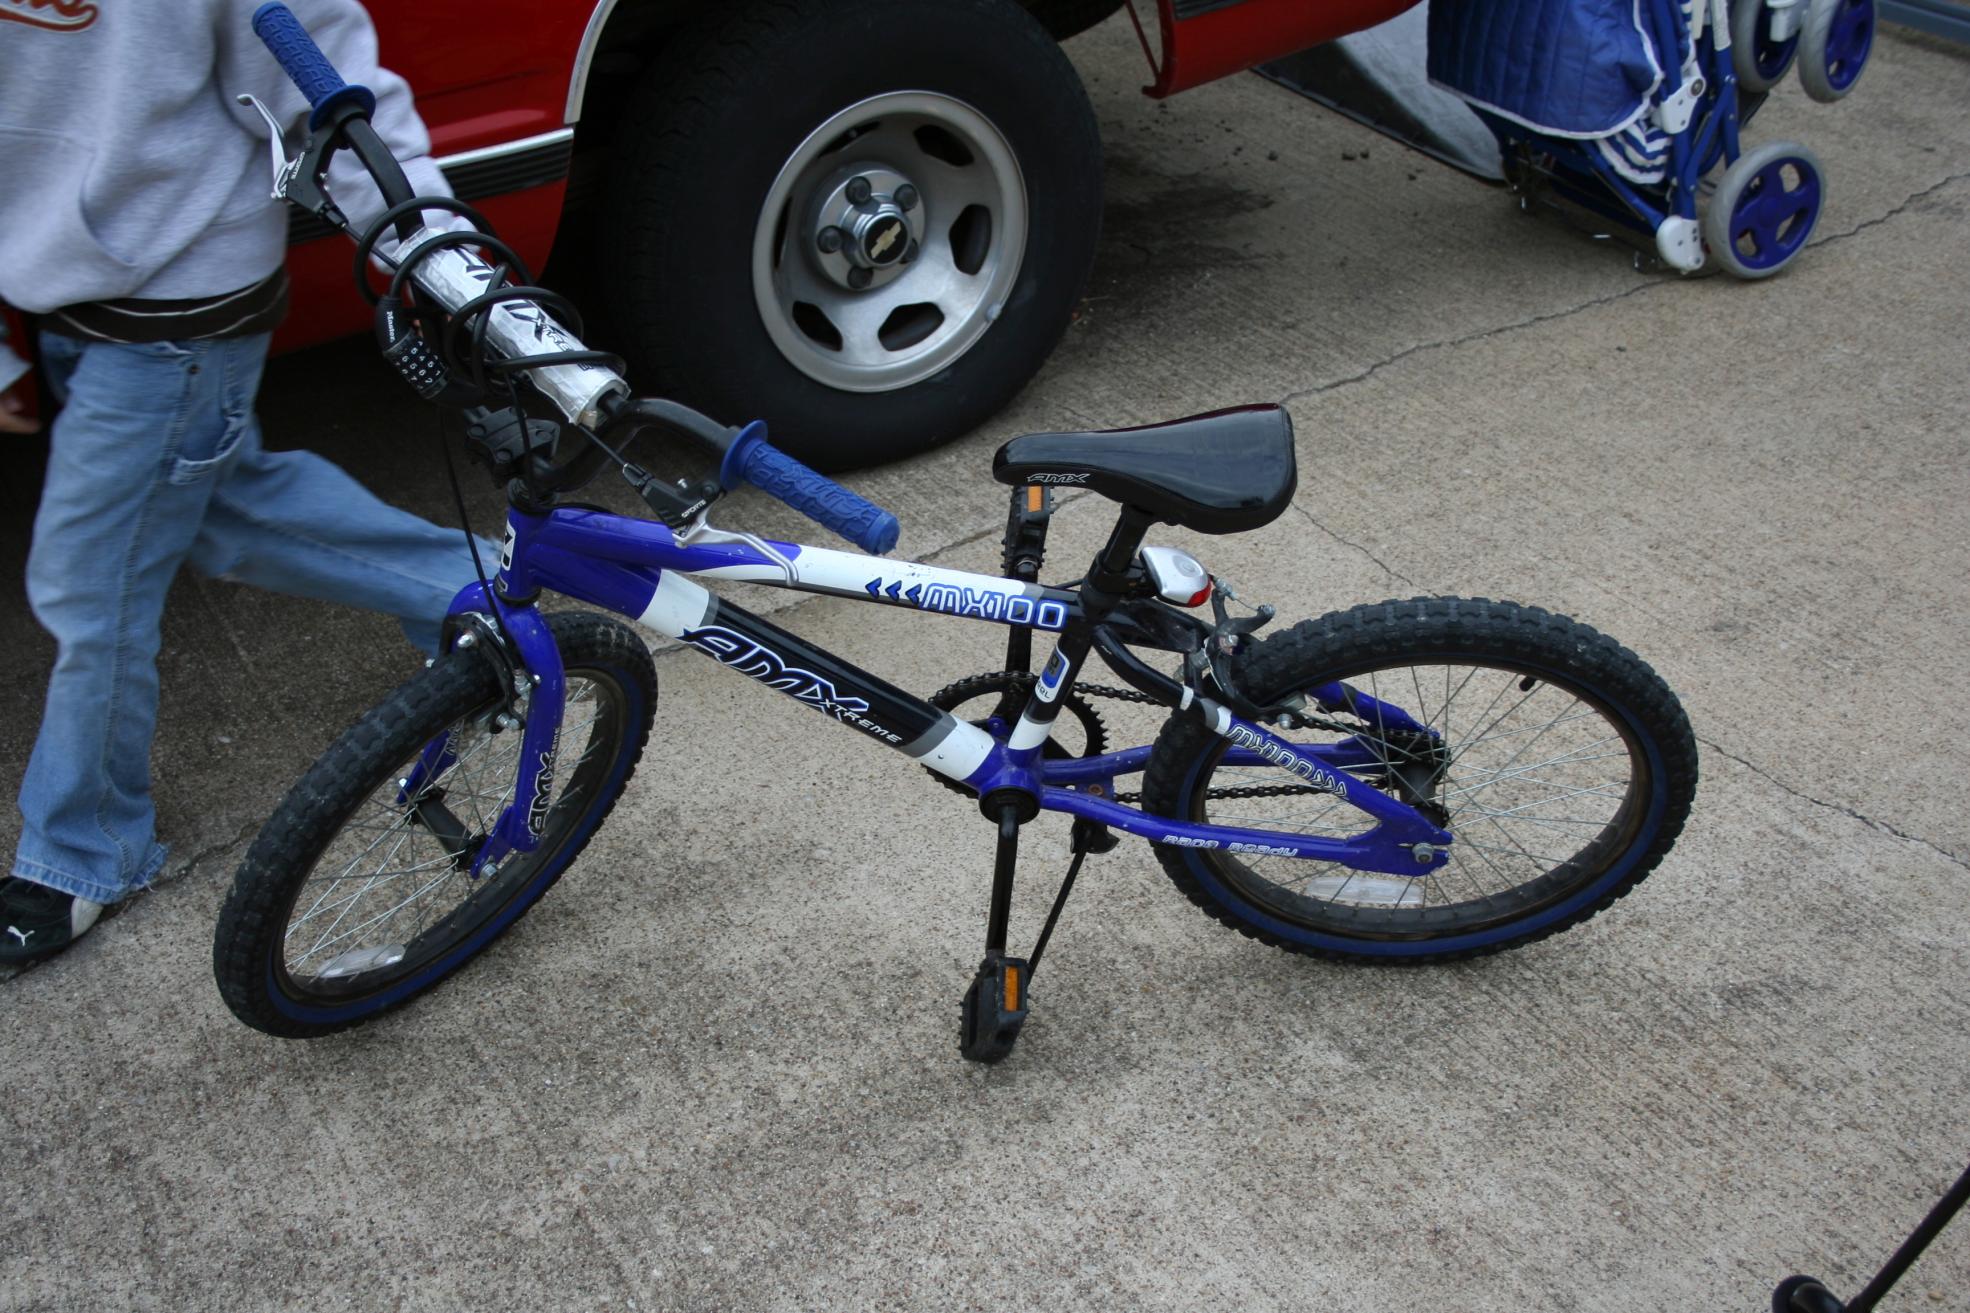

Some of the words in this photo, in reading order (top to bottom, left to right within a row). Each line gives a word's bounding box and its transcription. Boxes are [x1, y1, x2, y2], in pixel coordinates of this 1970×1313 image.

[1027, 473, 1091, 483] AMX
[921, 583, 1066, 631] MX100
[676, 625, 870, 722] AMX
[822, 697, 903, 743] XTREME
[1226, 723, 1314, 782] MX100
